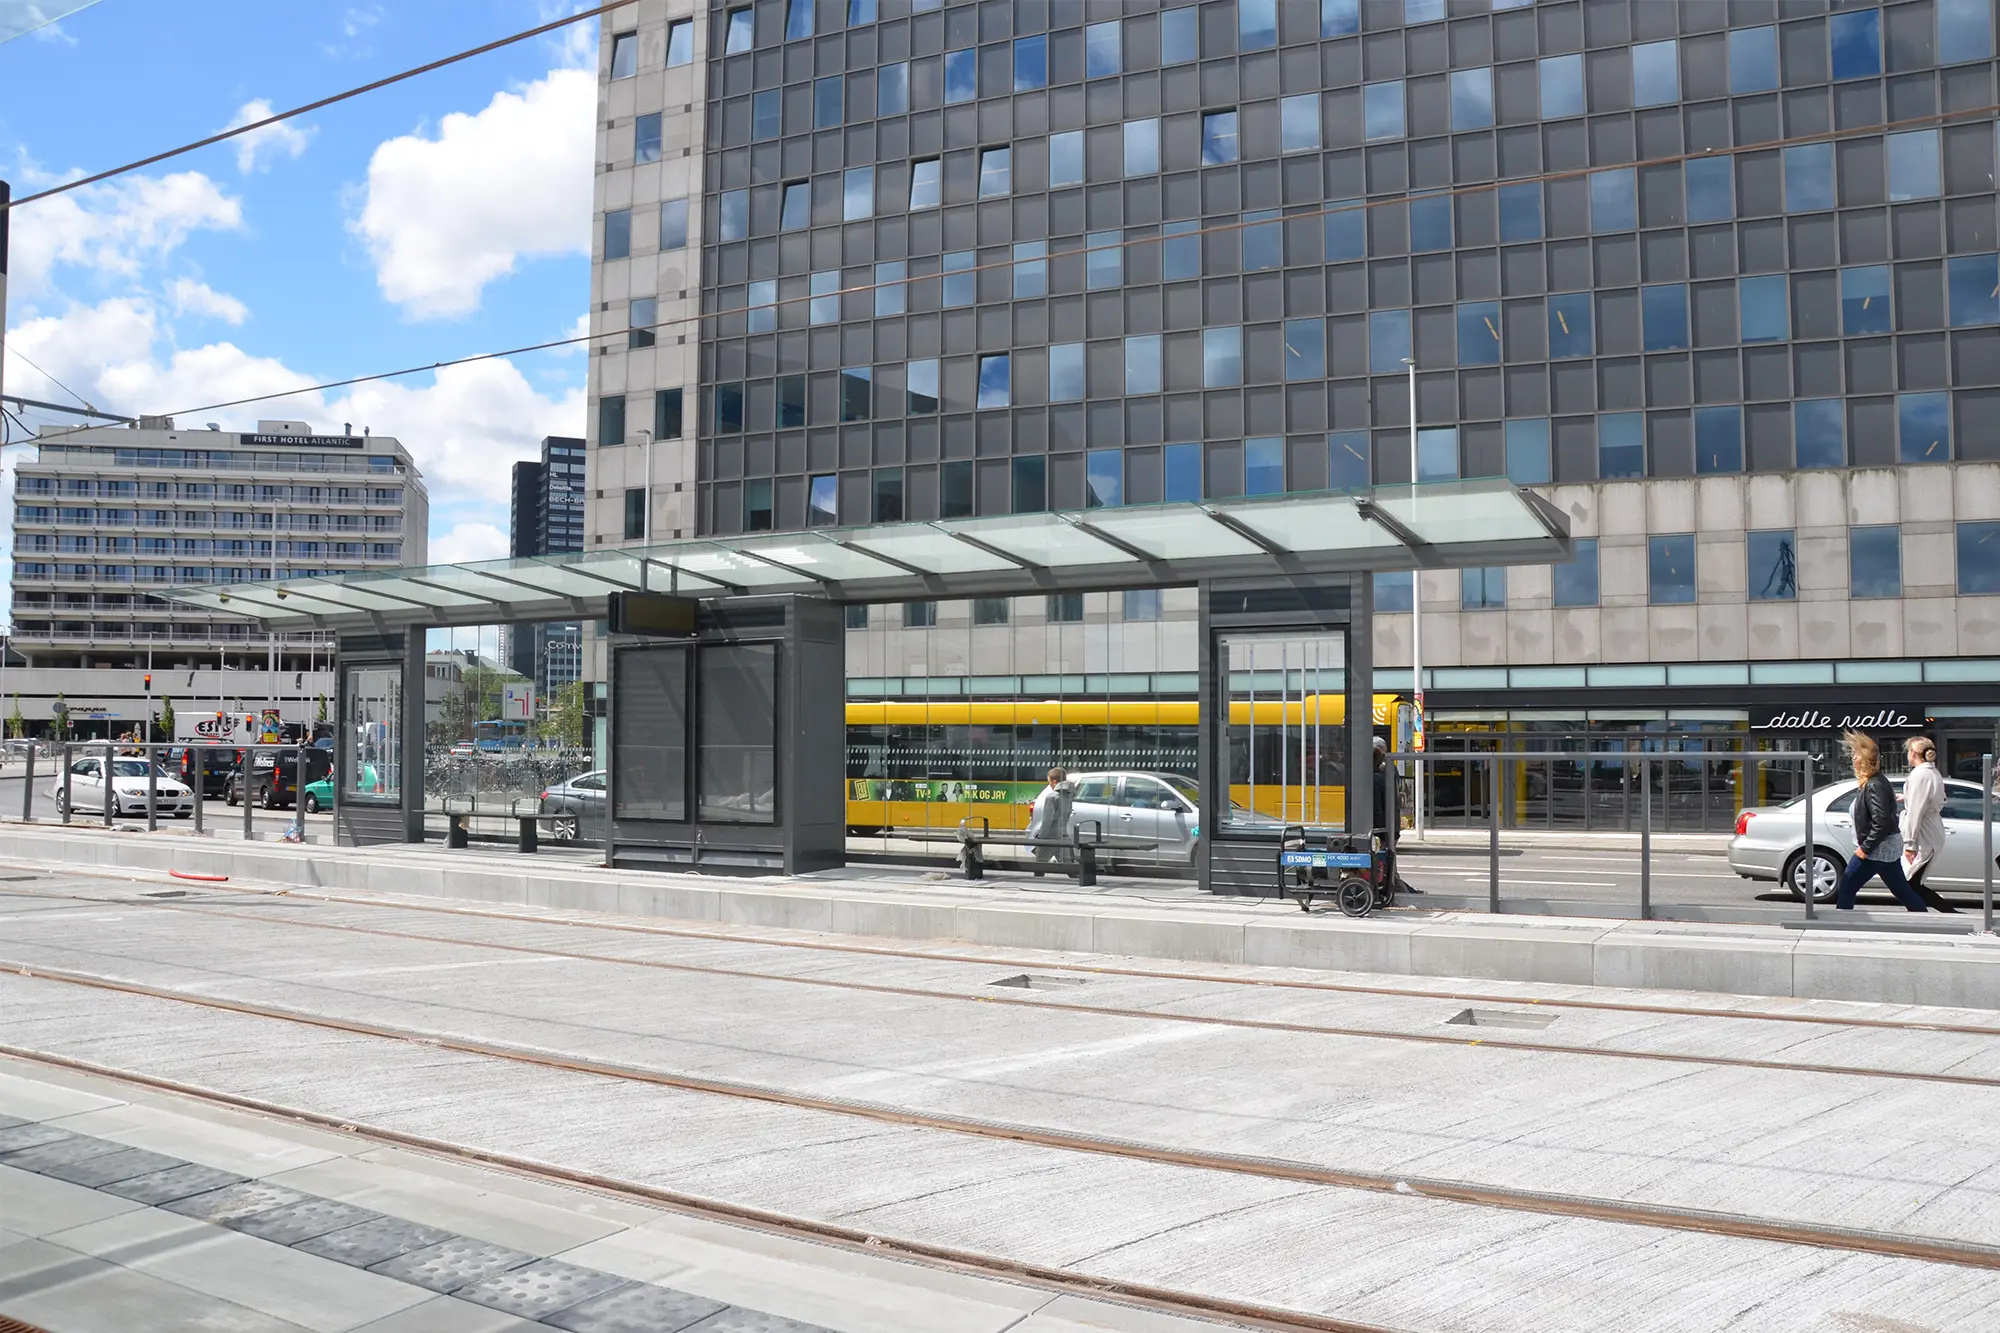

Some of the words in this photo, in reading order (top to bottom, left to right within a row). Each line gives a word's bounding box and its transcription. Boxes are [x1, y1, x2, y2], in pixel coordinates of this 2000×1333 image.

[280, 436, 309, 444] HOTEL
[311, 437, 350, 446] ATLANTIC
[1751, 711, 1832, 729] dalle
[1836, 710, 1924, 728] valle
[991, 790, 1007, 800] JAY
